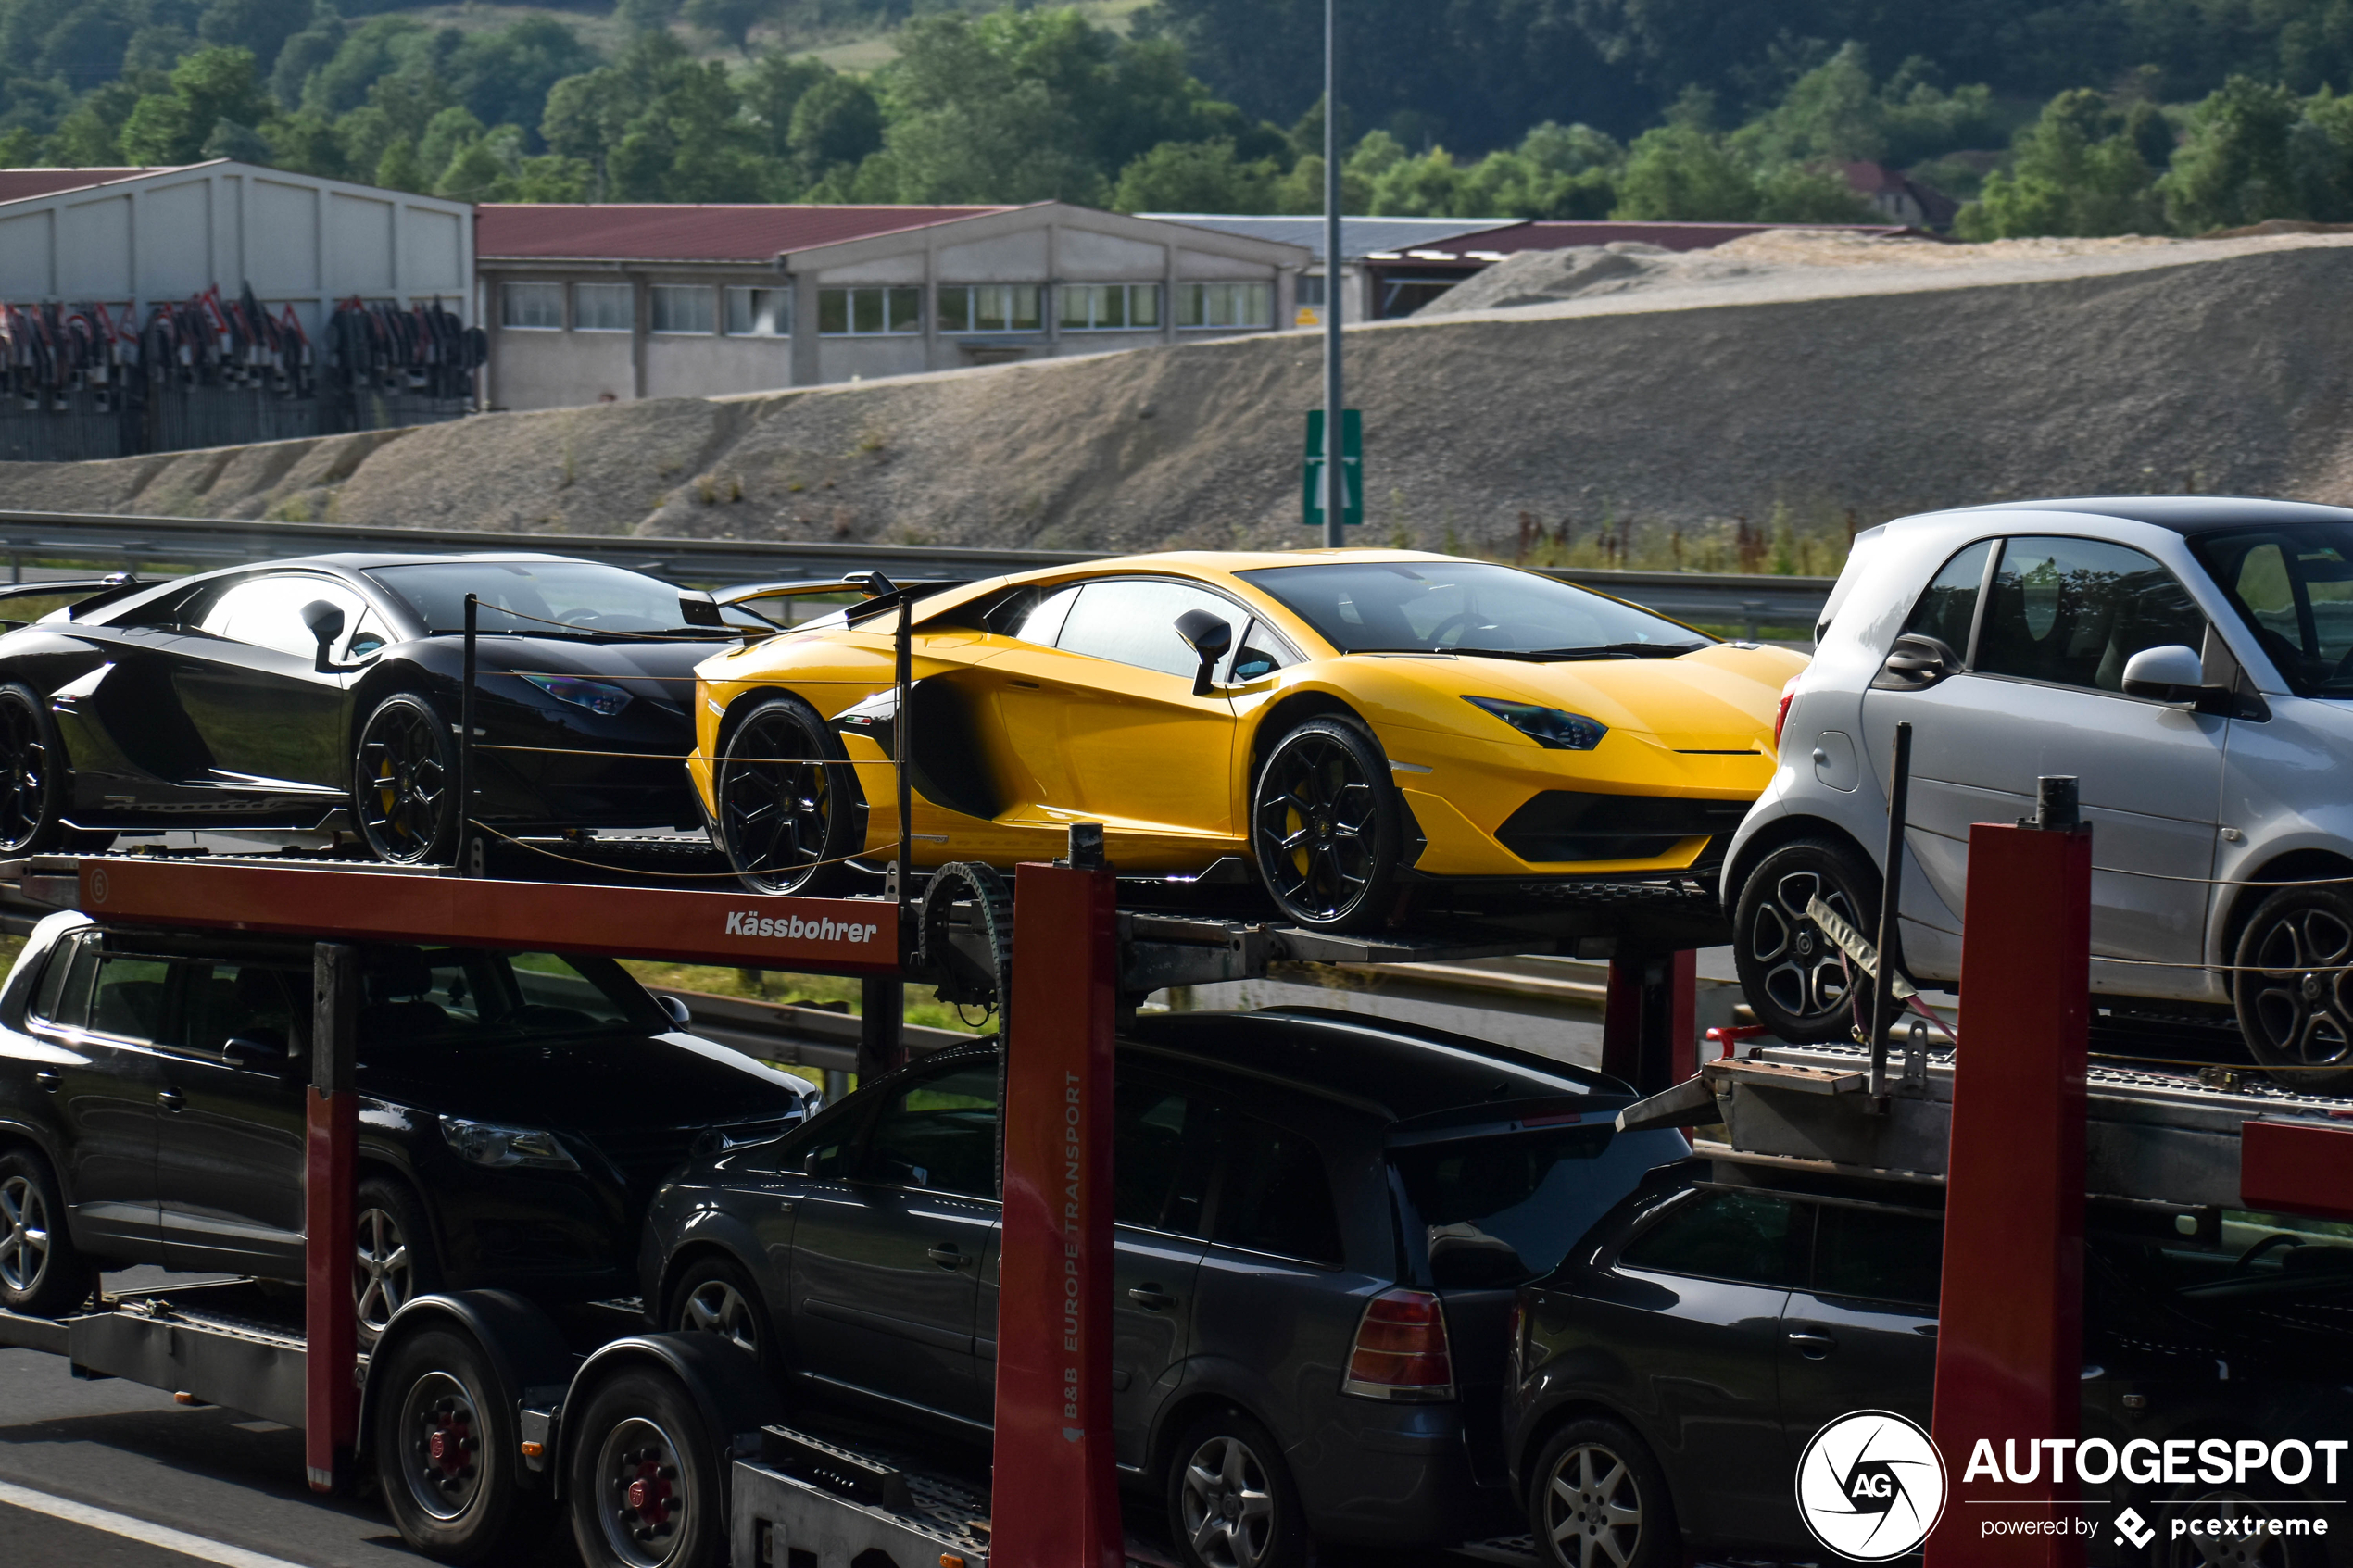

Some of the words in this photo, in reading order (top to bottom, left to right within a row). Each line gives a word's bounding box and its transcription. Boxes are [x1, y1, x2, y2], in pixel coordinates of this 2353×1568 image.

[94, 874, 104, 897] 6
[725, 910, 877, 943] Kässbohrer
[1064, 1070, 1081, 1237] TRANSPORT
[1064, 1242, 1079, 1353] EUROPE
[1064, 1367, 1078, 1420] B&B
